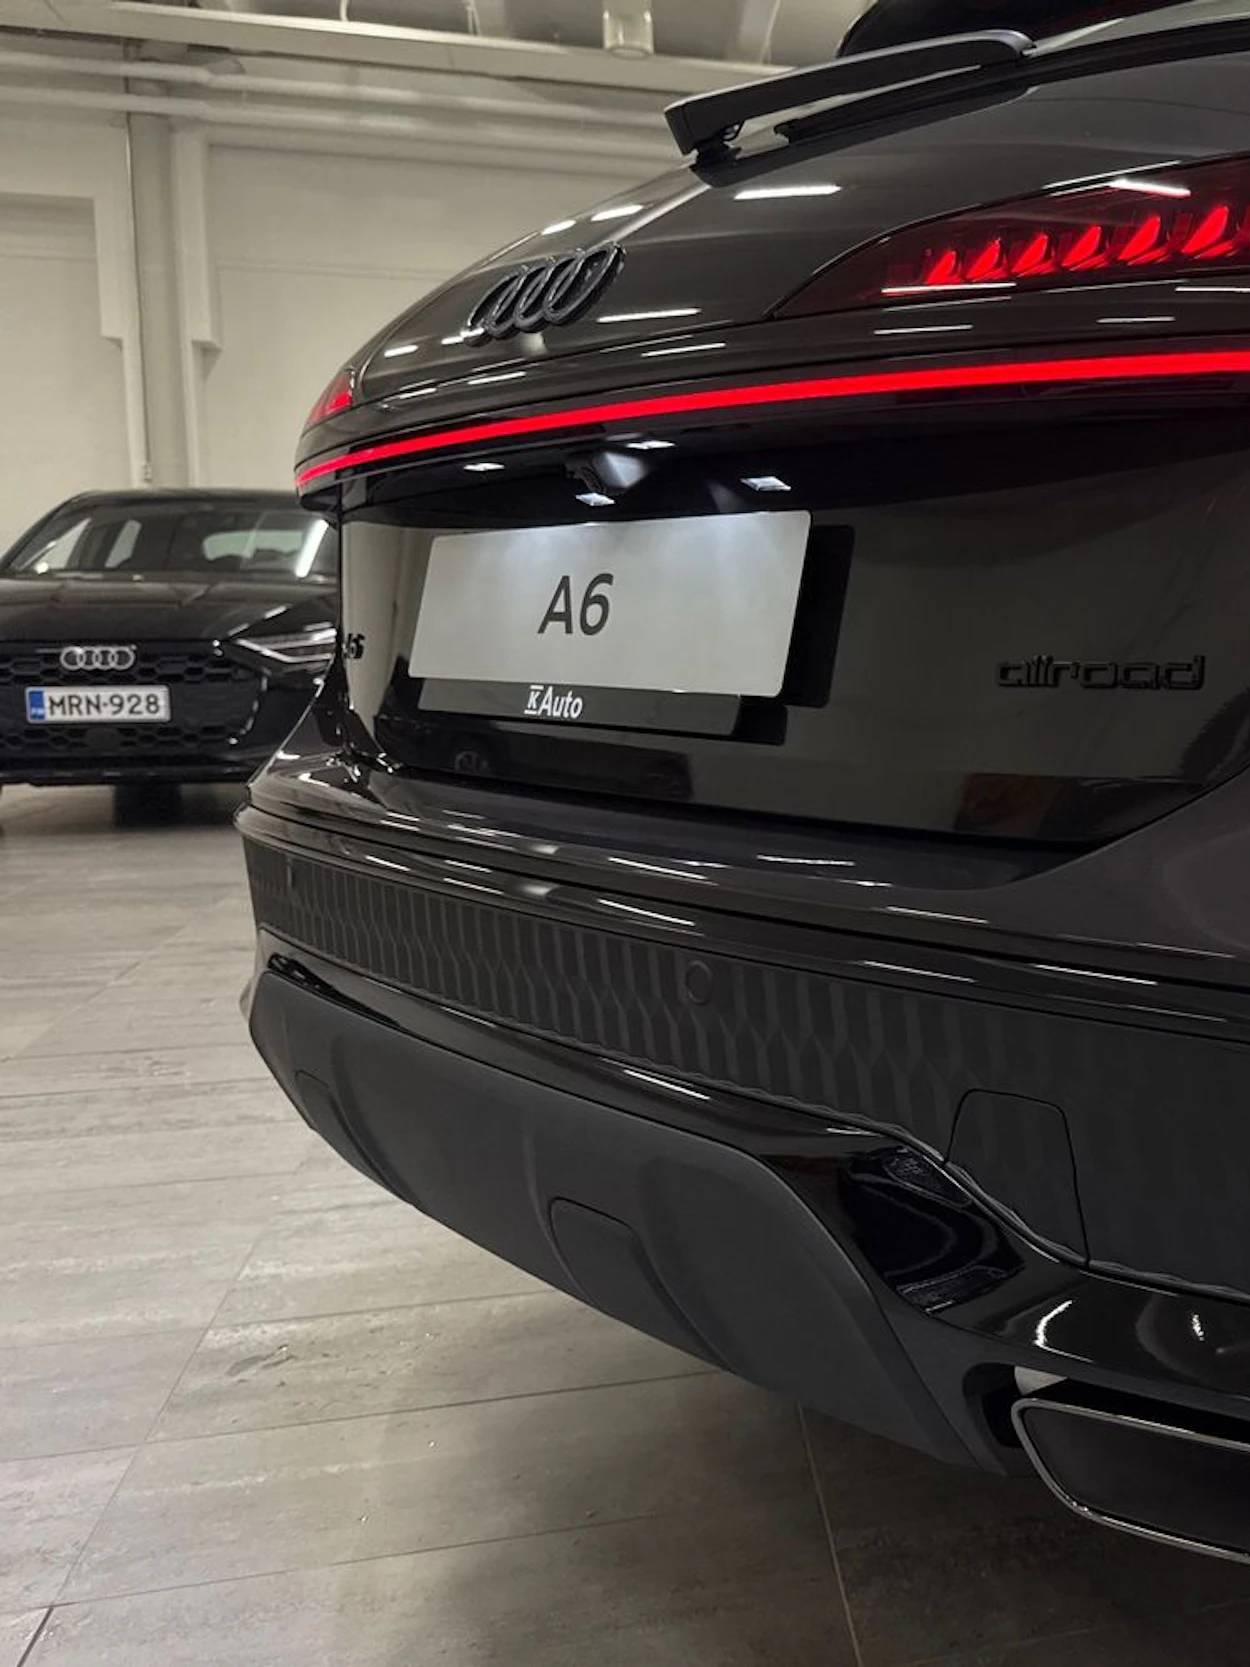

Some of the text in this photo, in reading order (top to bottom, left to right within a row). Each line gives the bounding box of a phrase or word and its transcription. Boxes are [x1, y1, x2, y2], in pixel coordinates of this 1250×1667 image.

[537, 572, 614, 636] A6
[997, 655, 1206, 692] allroad
[48, 694, 160, 716] MRN-928
